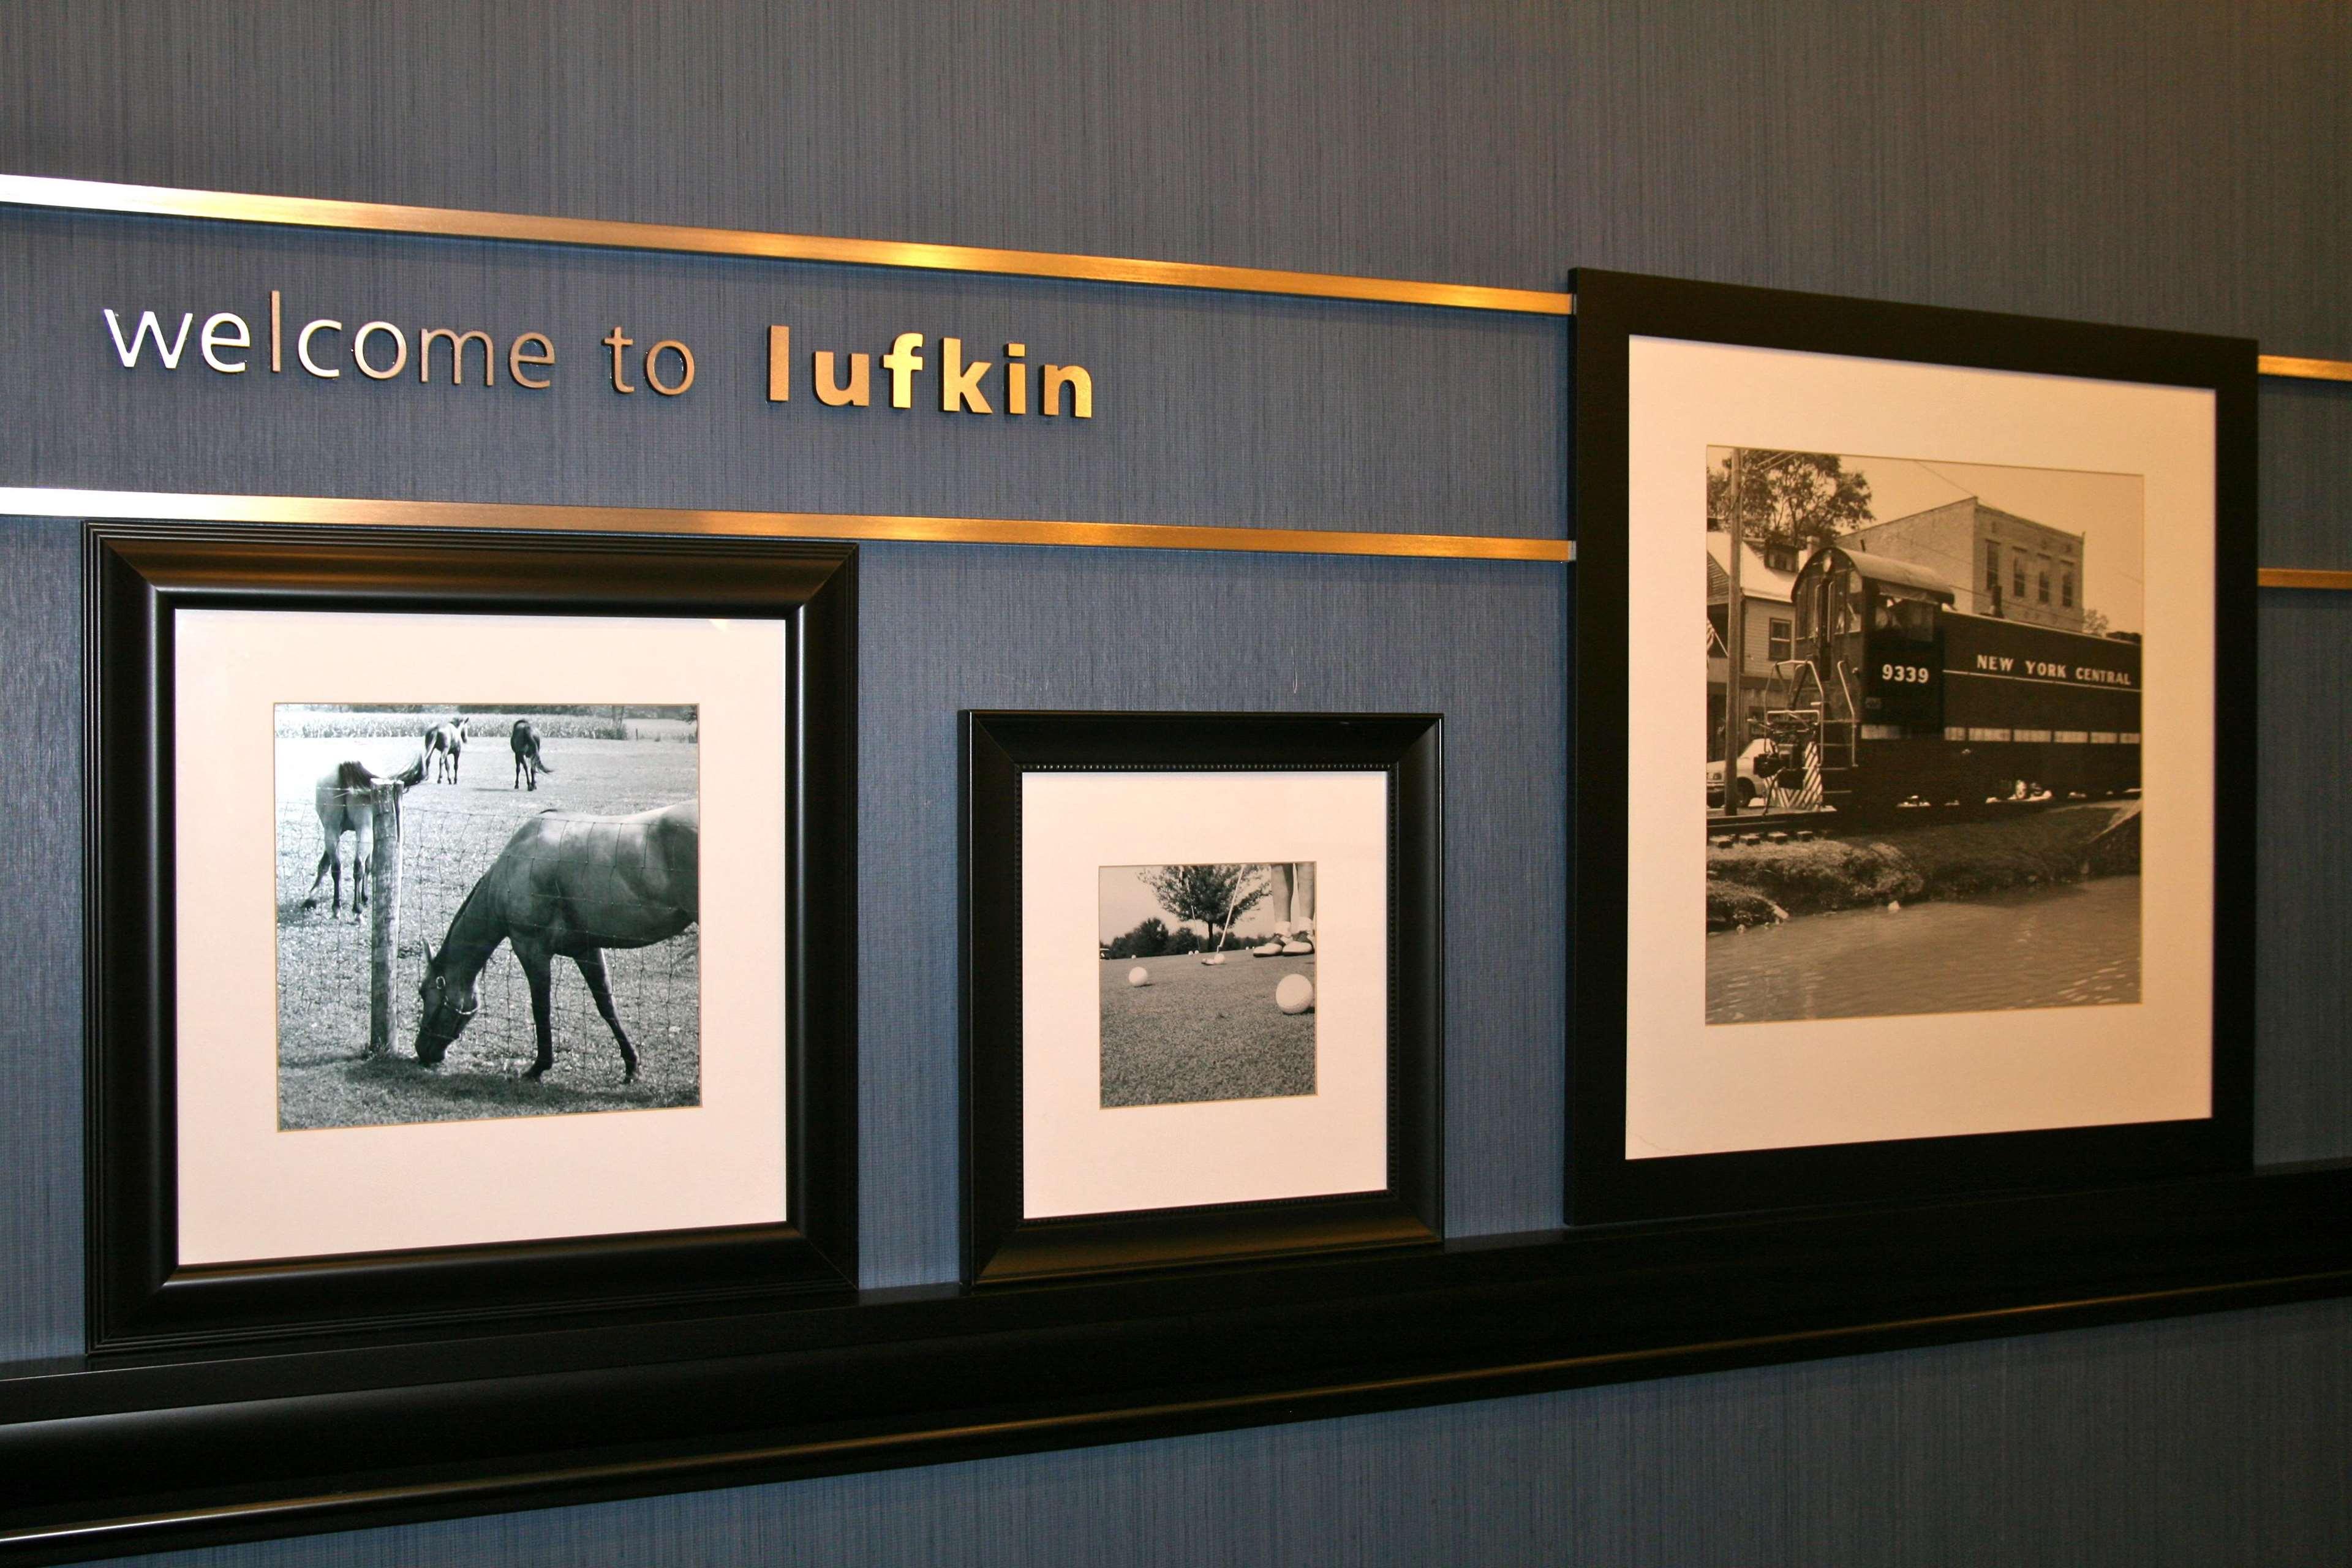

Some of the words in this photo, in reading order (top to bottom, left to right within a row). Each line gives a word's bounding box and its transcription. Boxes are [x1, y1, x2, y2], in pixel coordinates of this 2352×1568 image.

[104, 290, 556, 388] welcome
[602, 326, 695, 396] to
[767, 325, 1093, 418] lufkin
[1882, 664, 1929, 684] 9339
[1977, 654, 2014, 672] NEW
[2025, 660, 2067, 678] YORK
[2075, 667, 2131, 686] CENTRAL
